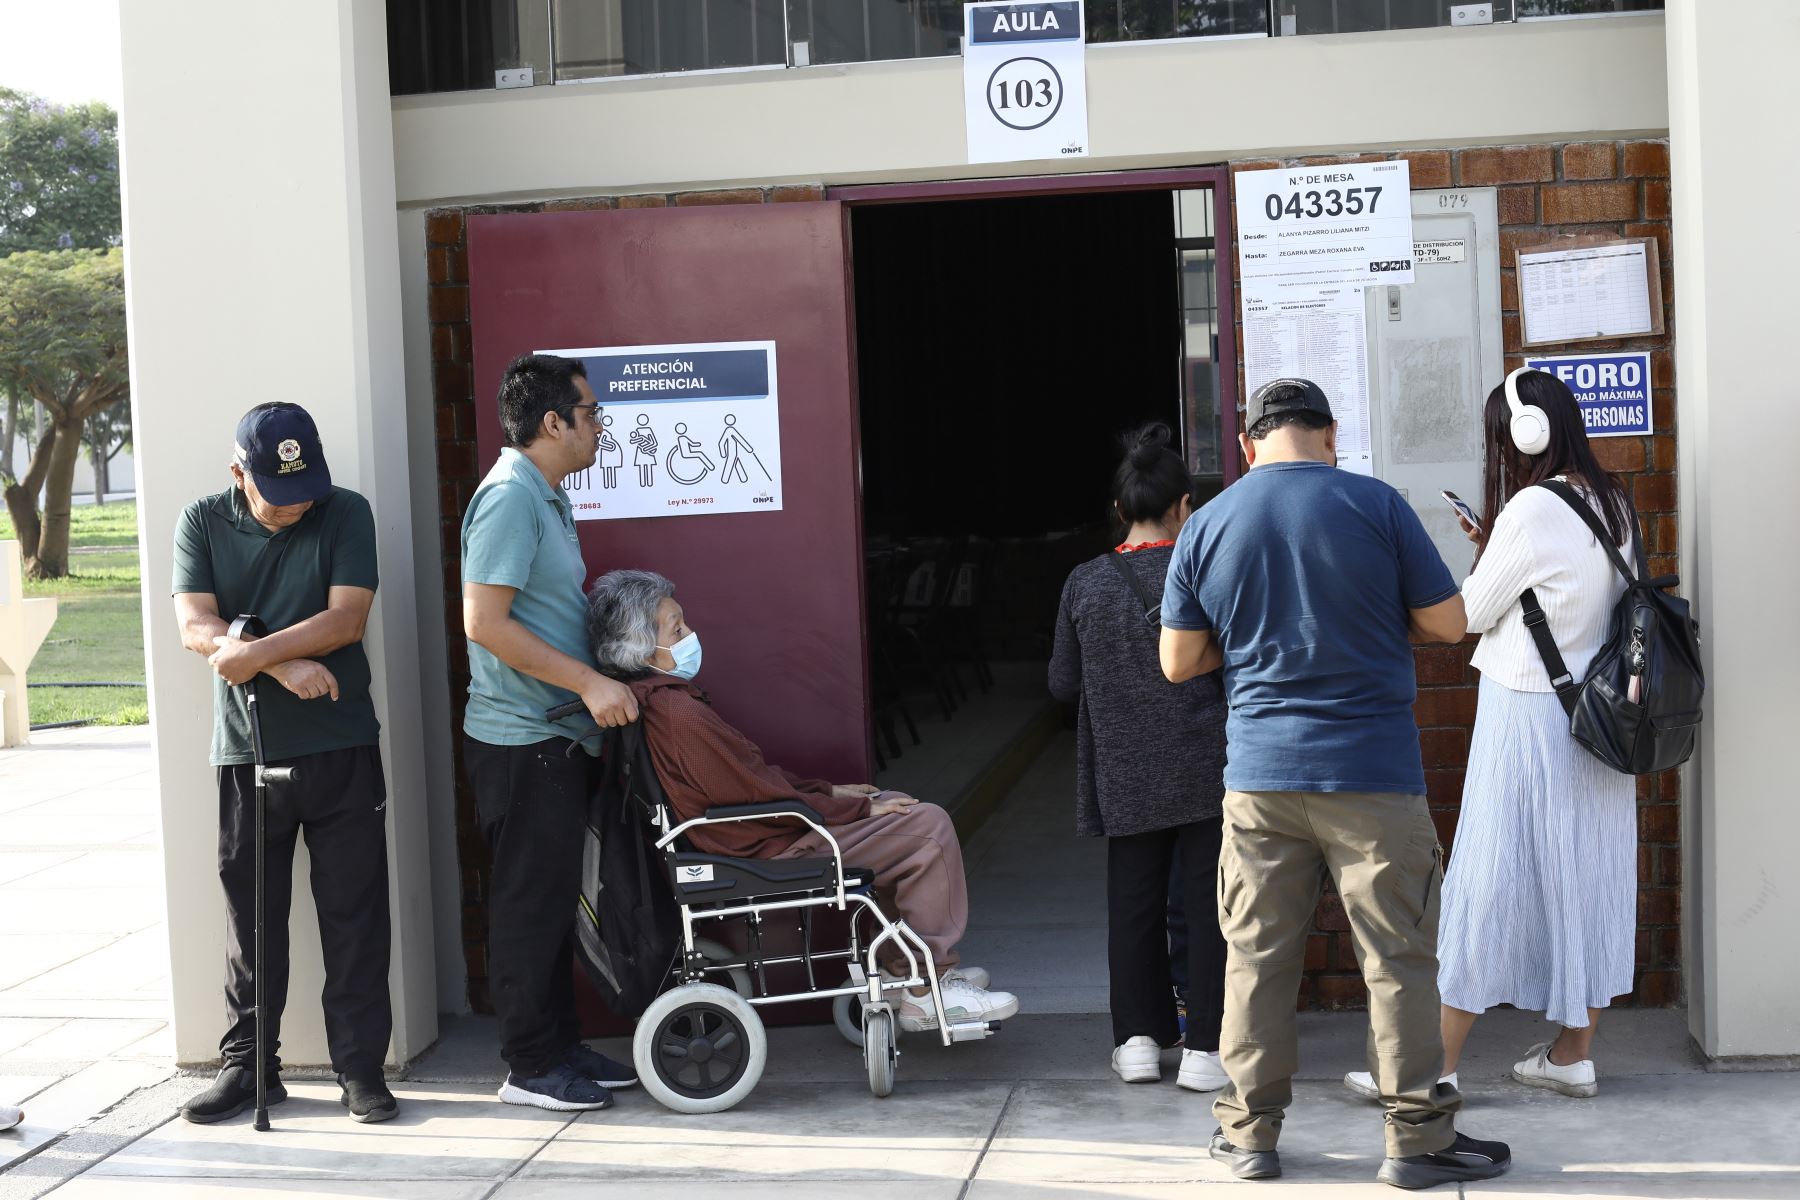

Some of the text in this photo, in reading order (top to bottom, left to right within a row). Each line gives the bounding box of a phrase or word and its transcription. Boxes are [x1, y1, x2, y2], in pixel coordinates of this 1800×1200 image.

[992, 10, 1060, 33] AULA
[996, 78, 1053, 109] 103
[1061, 146, 1083, 154] ONPE
[1306, 175, 1321, 185] DE
[1324, 173, 1355, 183] MESA
[1265, 186, 1383, 221] 043357
[1279, 249, 1308, 257] ZEGARRA
[622, 358, 694, 376] ATENCIÓN
[1540, 362, 1641, 389] FORO
[609, 377, 708, 393] PREFERENCIAL
[1573, 388, 1644, 402] DAD MÁXIMA
[579, 502, 601, 510] 28683
[667, 499, 680, 507] Ley
[752, 496, 774, 504] ONPE
